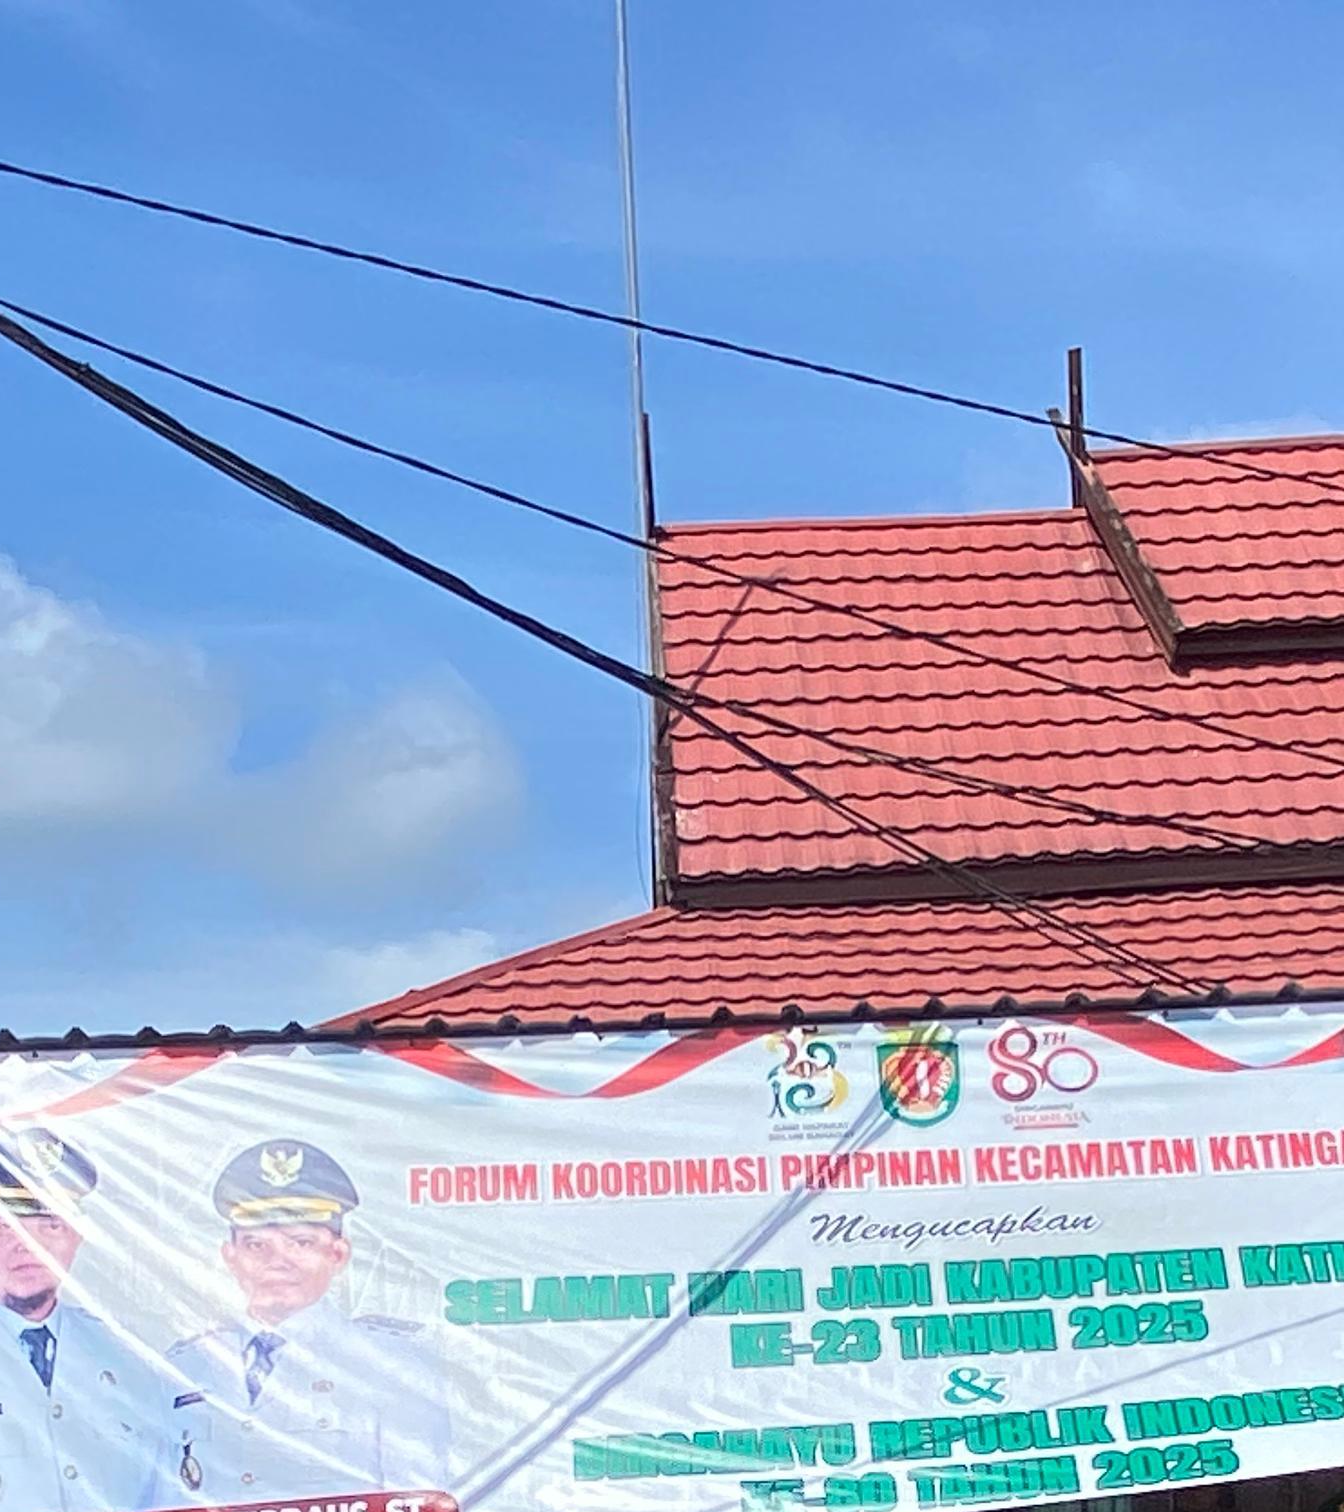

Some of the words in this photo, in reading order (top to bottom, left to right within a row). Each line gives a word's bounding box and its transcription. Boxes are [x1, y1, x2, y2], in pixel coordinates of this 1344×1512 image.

[409, 1164, 538, 1201] FORUM
[553, 1156, 768, 1199] KOORDINASI
[781, 1149, 959, 1192] PIMPINAN
[977, 1138, 1197, 1183] KECAMATAN
[810, 1206, 1097, 1249] Mengucapkan
[444, 1273, 675, 1325] SELAMAT
[688, 1267, 805, 1317] HARI
[817, 1264, 932, 1310] JADI
[944, 1247, 1228, 1304] KABUPATEN
[730, 1319, 882, 1368] KE-23
[893, 1309, 1057, 1360] TAHUN
[1069, 1300, 1209, 1350] 2025
[944, 1366, 1006, 1404] &
[869, 1405, 1115, 1462] REPUBLIK
[908, 1455, 1080, 1510] TAHUN
[1092, 1439, 1240, 1490] 2025
